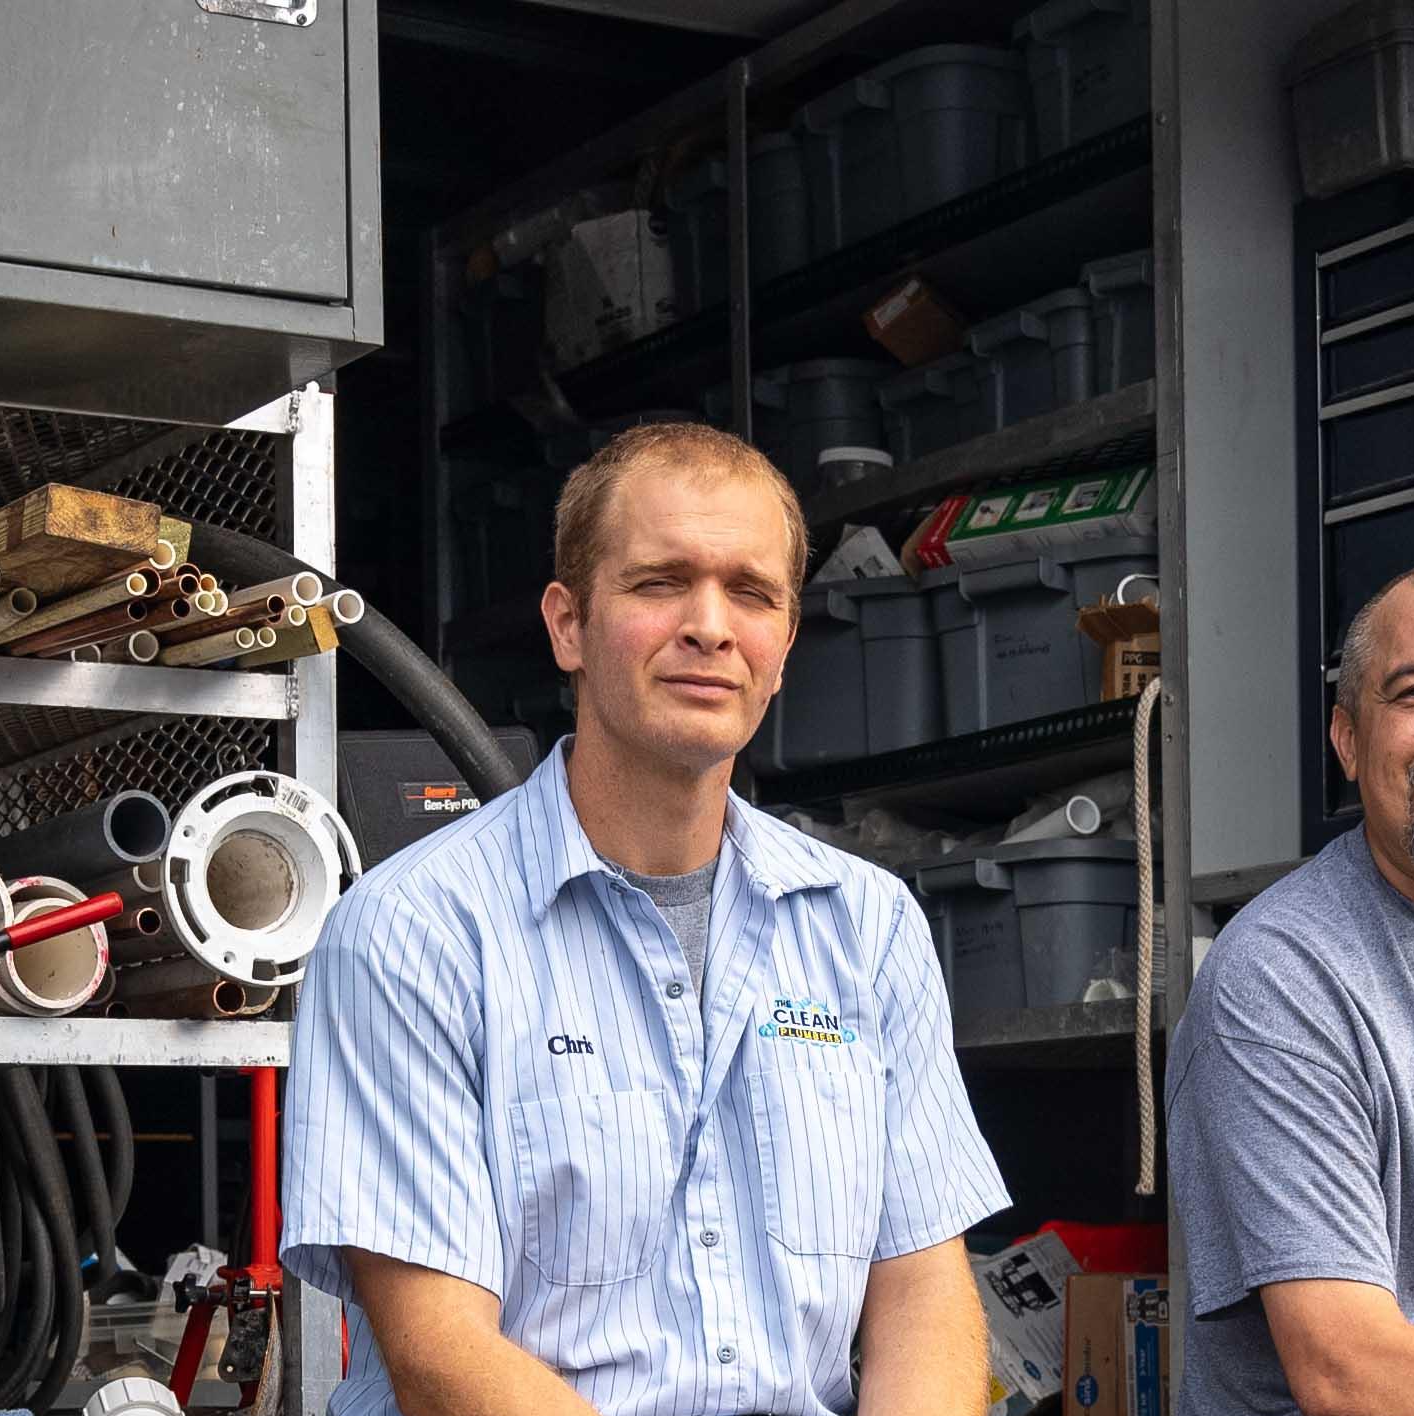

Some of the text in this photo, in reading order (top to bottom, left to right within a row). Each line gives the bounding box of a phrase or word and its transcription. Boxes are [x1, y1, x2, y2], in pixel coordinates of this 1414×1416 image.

[774, 999, 793, 1009] THE
[772, 1008, 840, 1031] CLEAN
[547, 1034, 595, 1056] Chris
[779, 1026, 842, 1044] PLUMBERS
